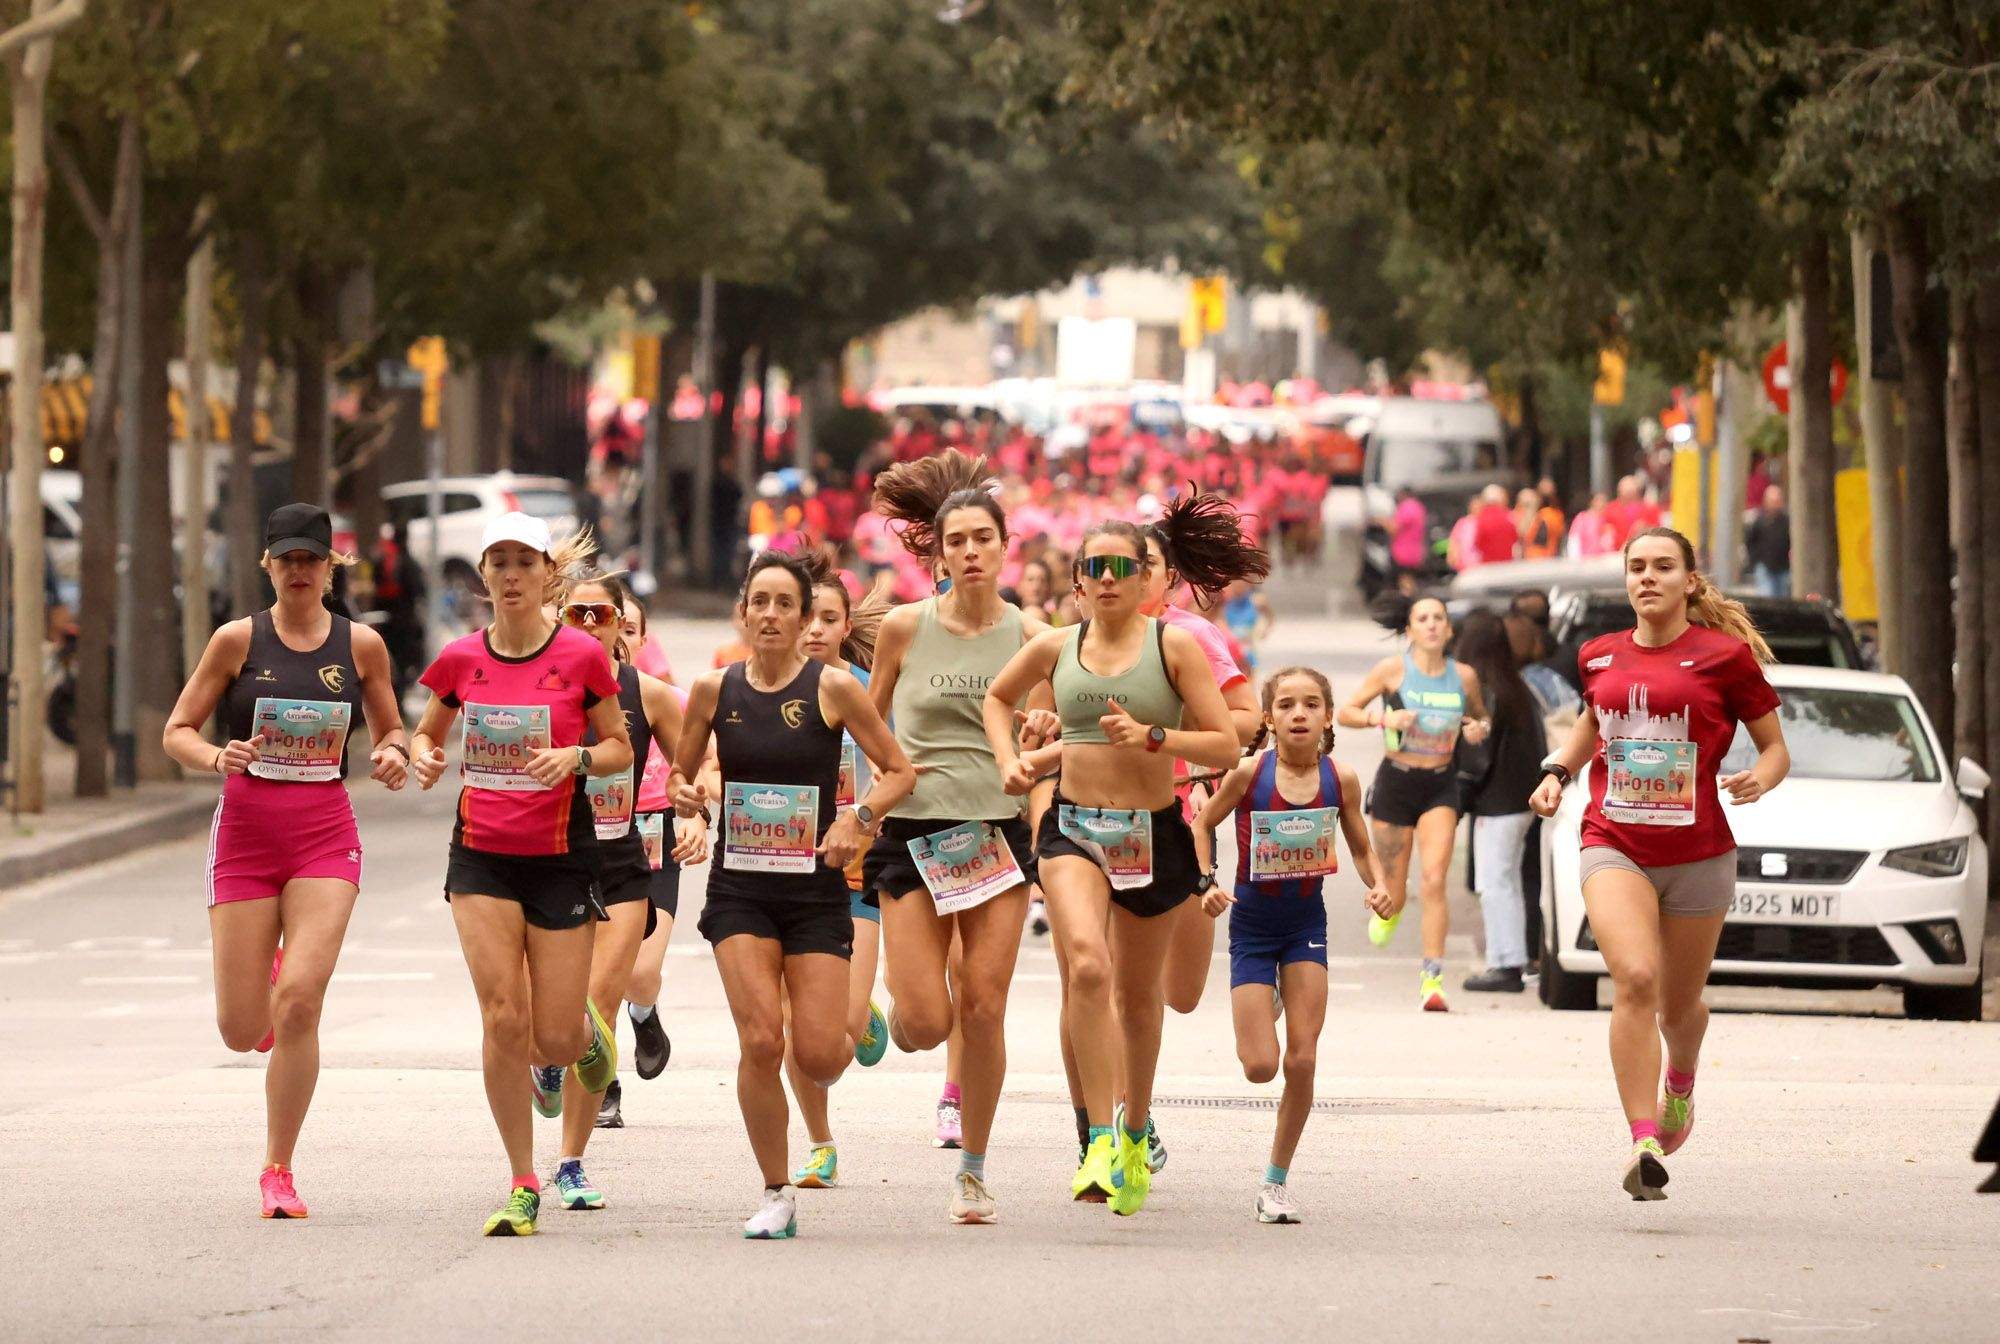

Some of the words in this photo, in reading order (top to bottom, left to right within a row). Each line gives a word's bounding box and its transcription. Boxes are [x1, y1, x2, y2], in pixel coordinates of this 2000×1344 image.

[1077, 692, 1128, 704] OYSHO
[283, 735, 316, 749] 016
[488, 742, 520, 757] 016
[1632, 778, 1665, 792] 016
[752, 823, 786, 837] 016
[1281, 848, 1314, 861] 016
[950, 857, 983, 878] 016
[1791, 894, 1834, 916] MDT
